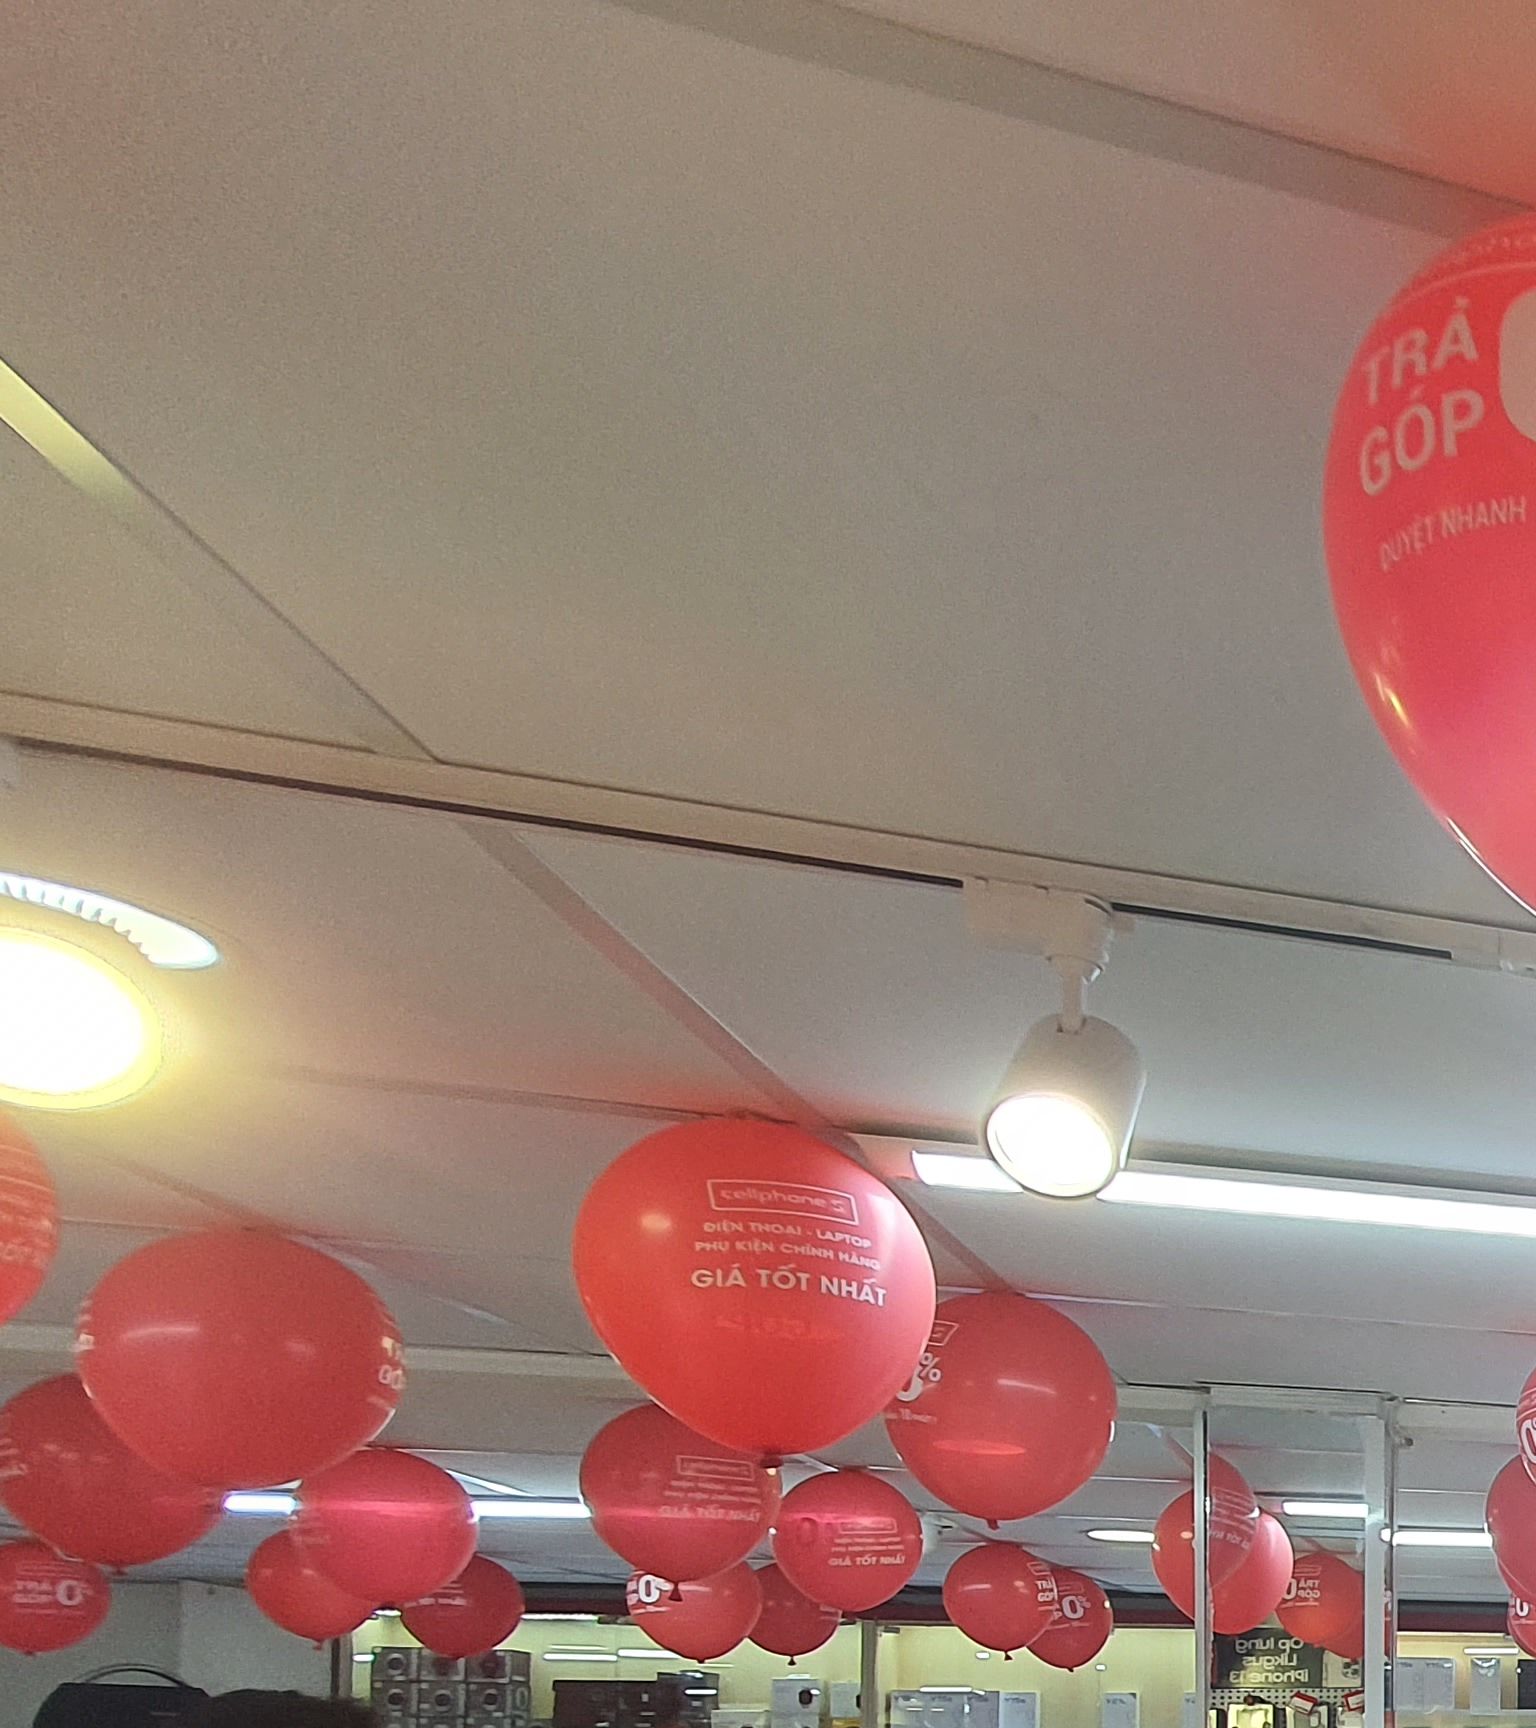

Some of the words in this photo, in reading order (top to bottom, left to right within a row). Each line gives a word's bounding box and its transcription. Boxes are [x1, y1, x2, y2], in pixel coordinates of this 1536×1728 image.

[1362, 295, 1479, 406] TRẢ
[1360, 384, 1485, 495] GÓP
[1440, 495, 1526, 539] NHANH
[816, 1228, 872, 1249] LAPTOP
[691, 1263, 747, 1289] GIÁ
[756, 1264, 810, 1291] TỐT
[821, 1277, 887, 1307] NHẤT
